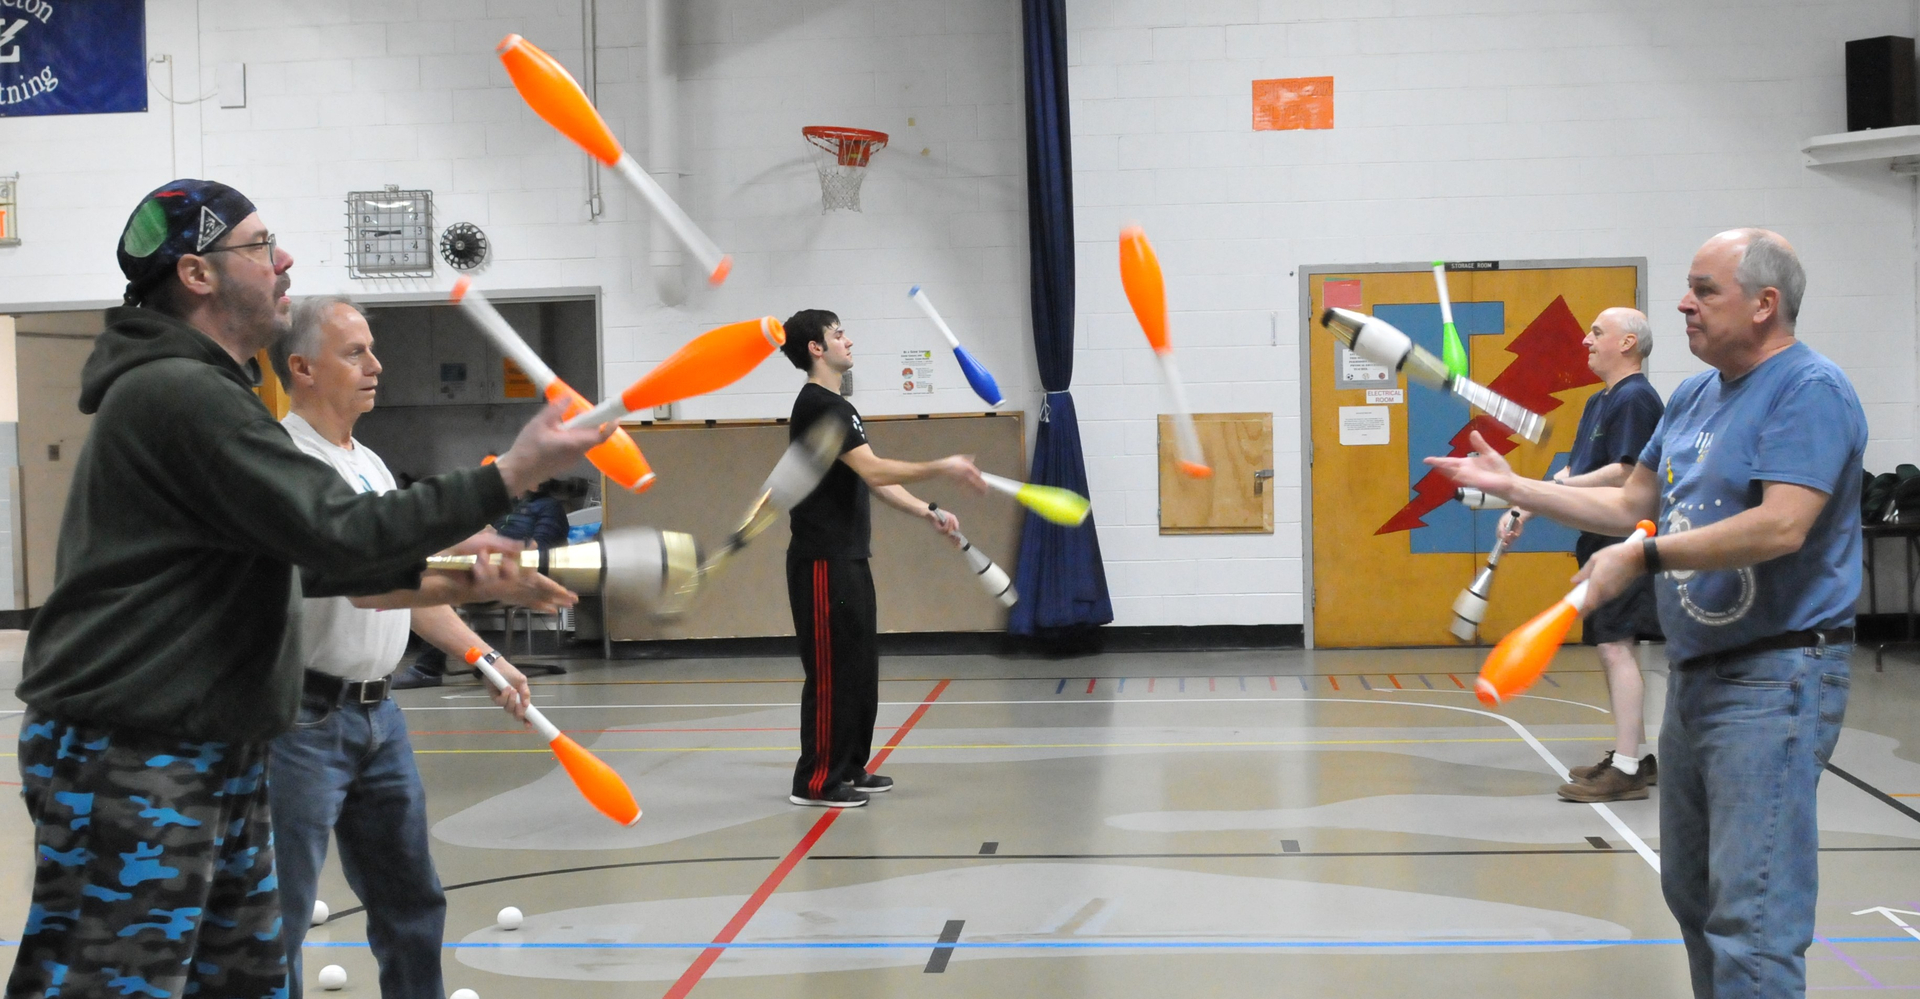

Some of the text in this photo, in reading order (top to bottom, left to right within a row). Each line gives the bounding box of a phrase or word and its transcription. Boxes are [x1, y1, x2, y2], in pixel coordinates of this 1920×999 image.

[418, 226, 422, 235] 3
[412, 241, 418, 250] 4
[404, 254, 409, 262] 5
